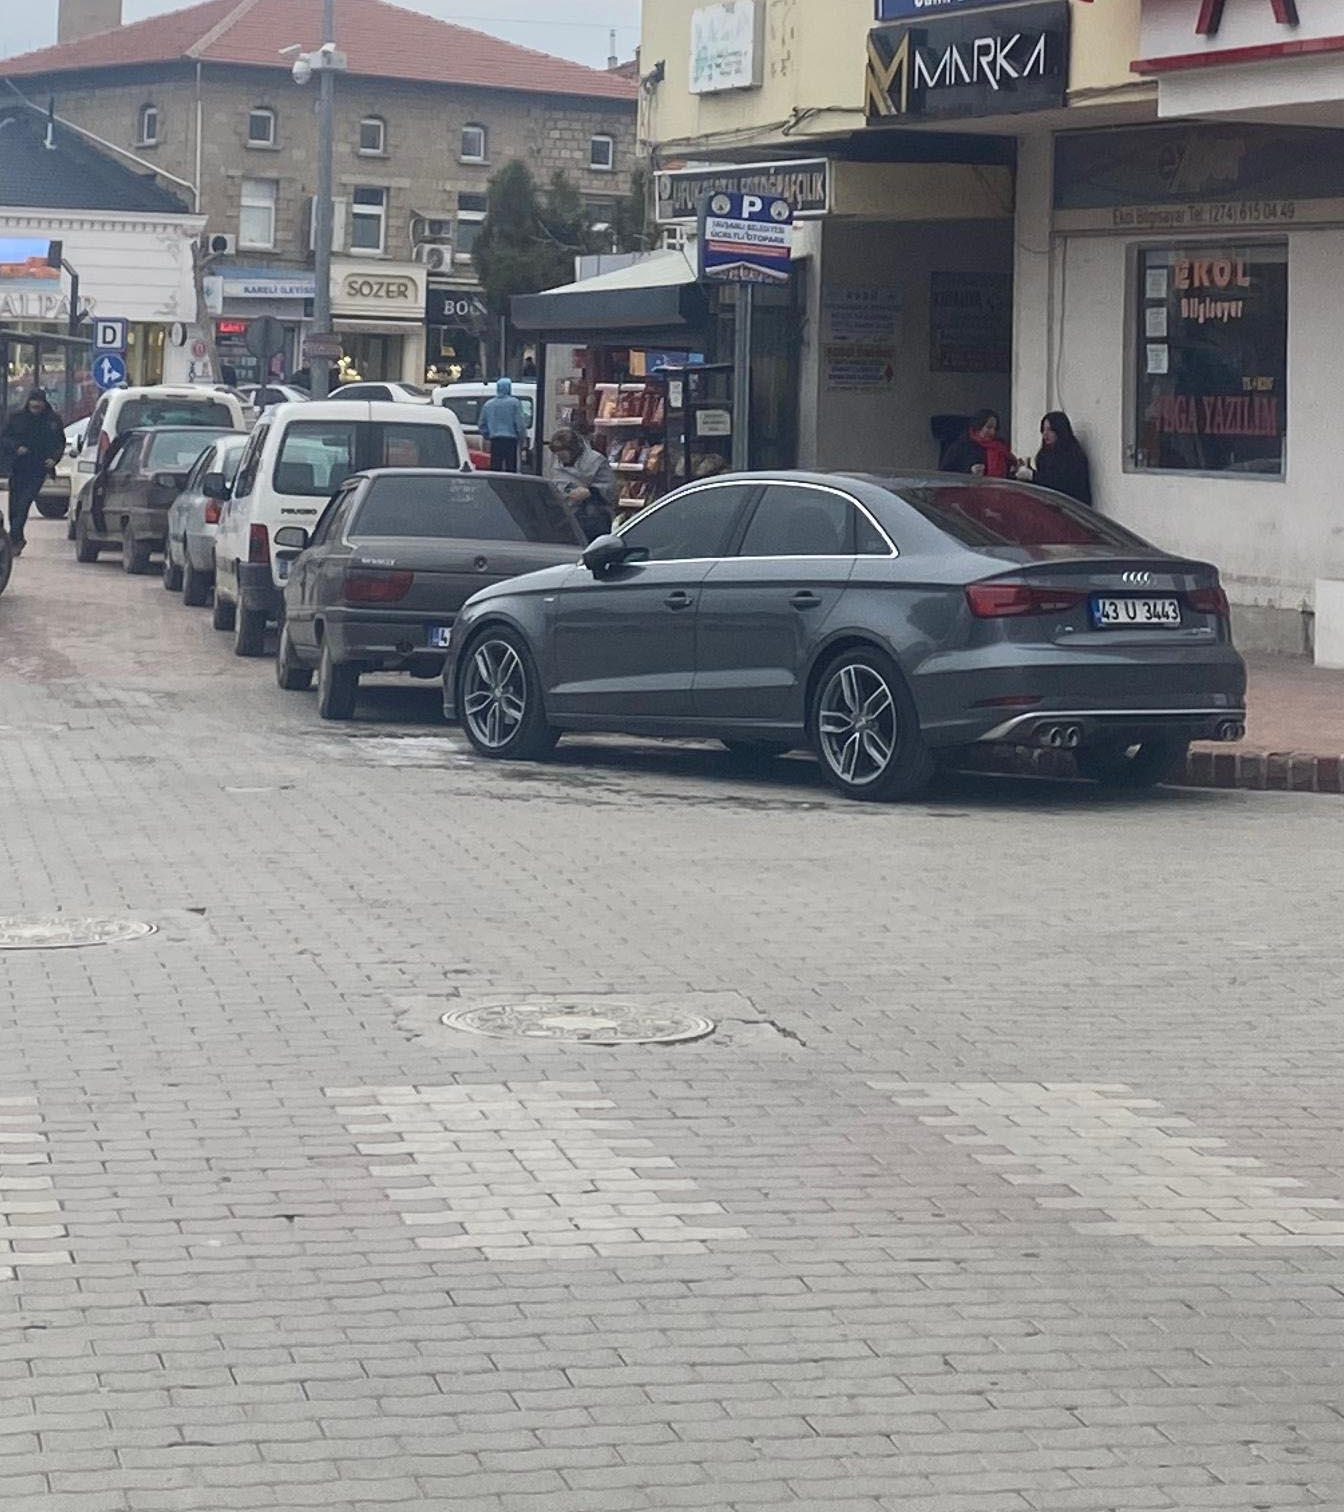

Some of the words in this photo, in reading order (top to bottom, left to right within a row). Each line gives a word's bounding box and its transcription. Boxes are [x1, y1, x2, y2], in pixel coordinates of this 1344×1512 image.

[914, 32, 1047, 90] MARKA
[742, 195, 763, 219] P
[1174, 258, 1251, 290] EKOL
[101, 326, 116, 344] D
[1101, 600, 1119, 621] 43
[1124, 601, 1137, 621] U
[1142, 600, 1179, 621] 3443
